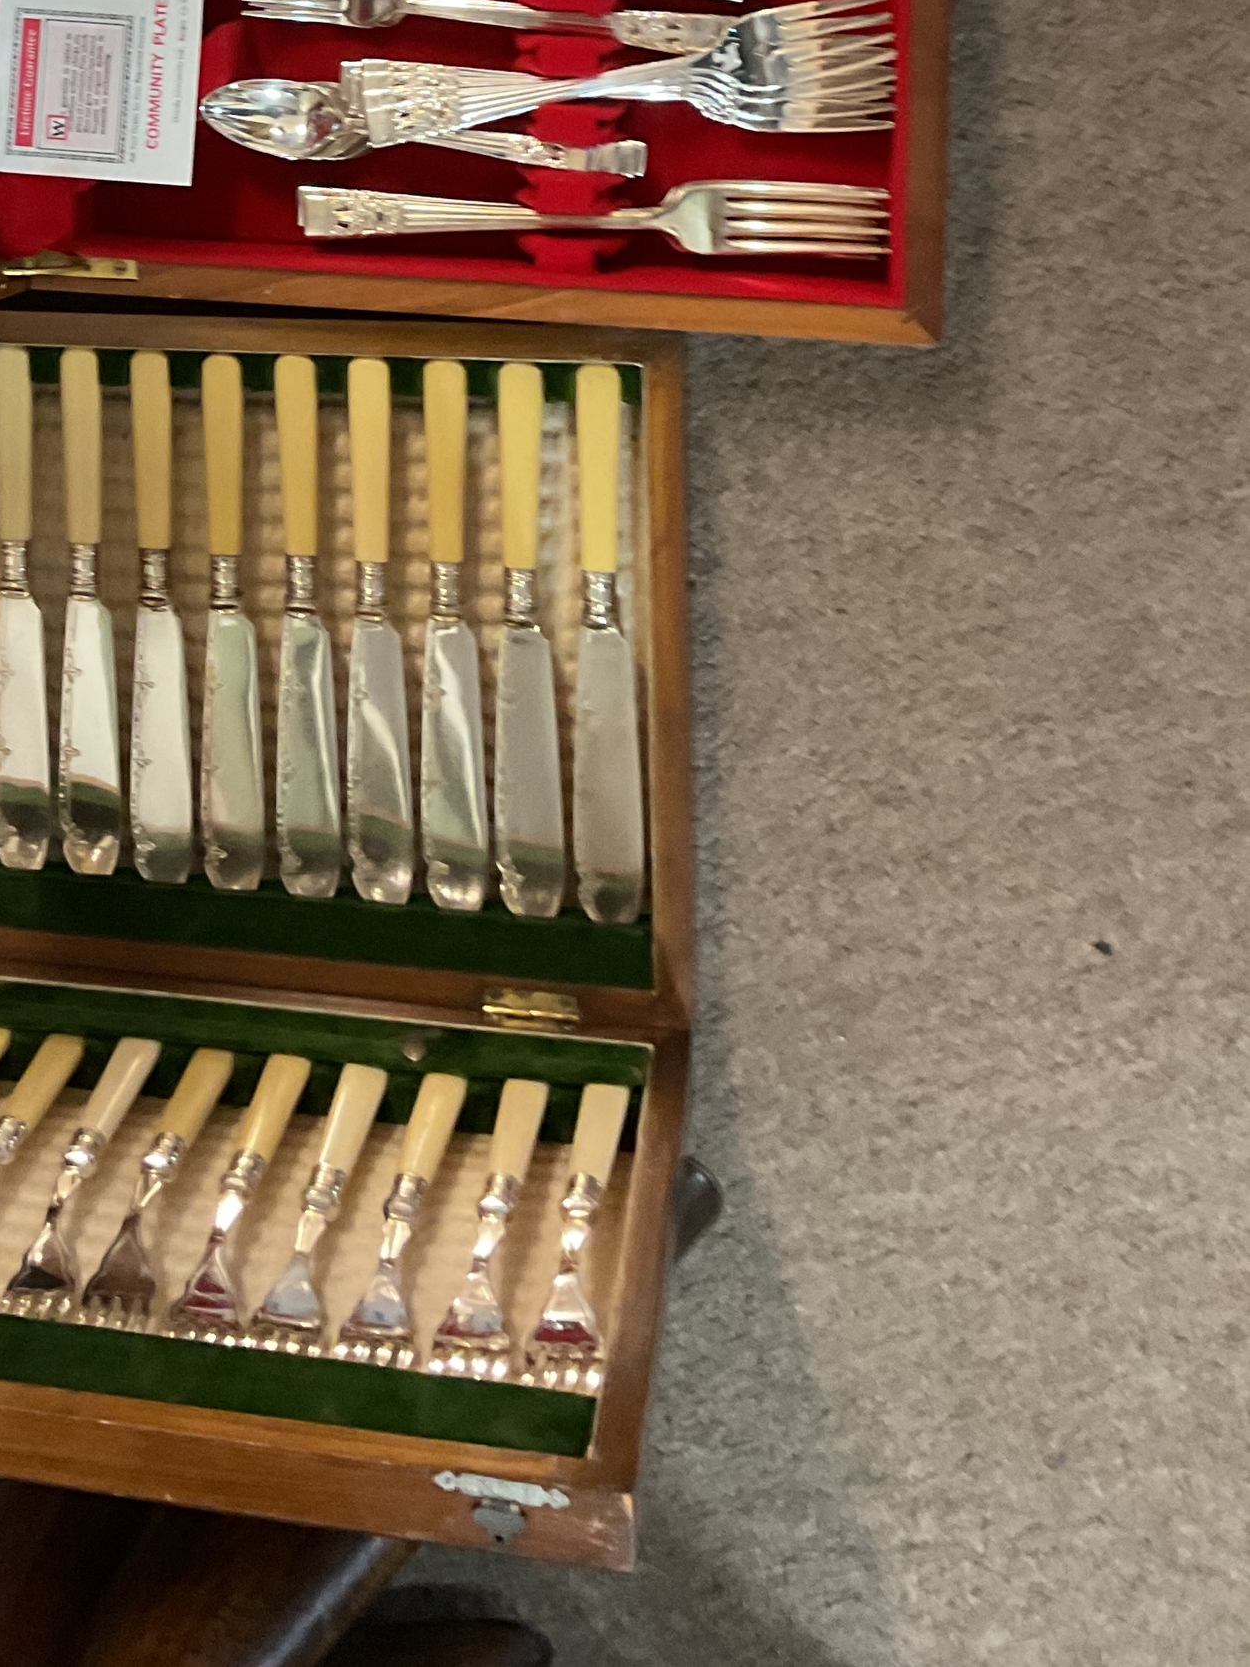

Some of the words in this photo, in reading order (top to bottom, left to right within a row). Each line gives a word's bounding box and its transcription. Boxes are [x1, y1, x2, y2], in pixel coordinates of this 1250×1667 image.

[150, 0, 169, 46] PLATE
[21, 28, 38, 88] Guarantee
[19, 91, 34, 137] Lifetime
[145, 54, 165, 150] COMMUNITY
